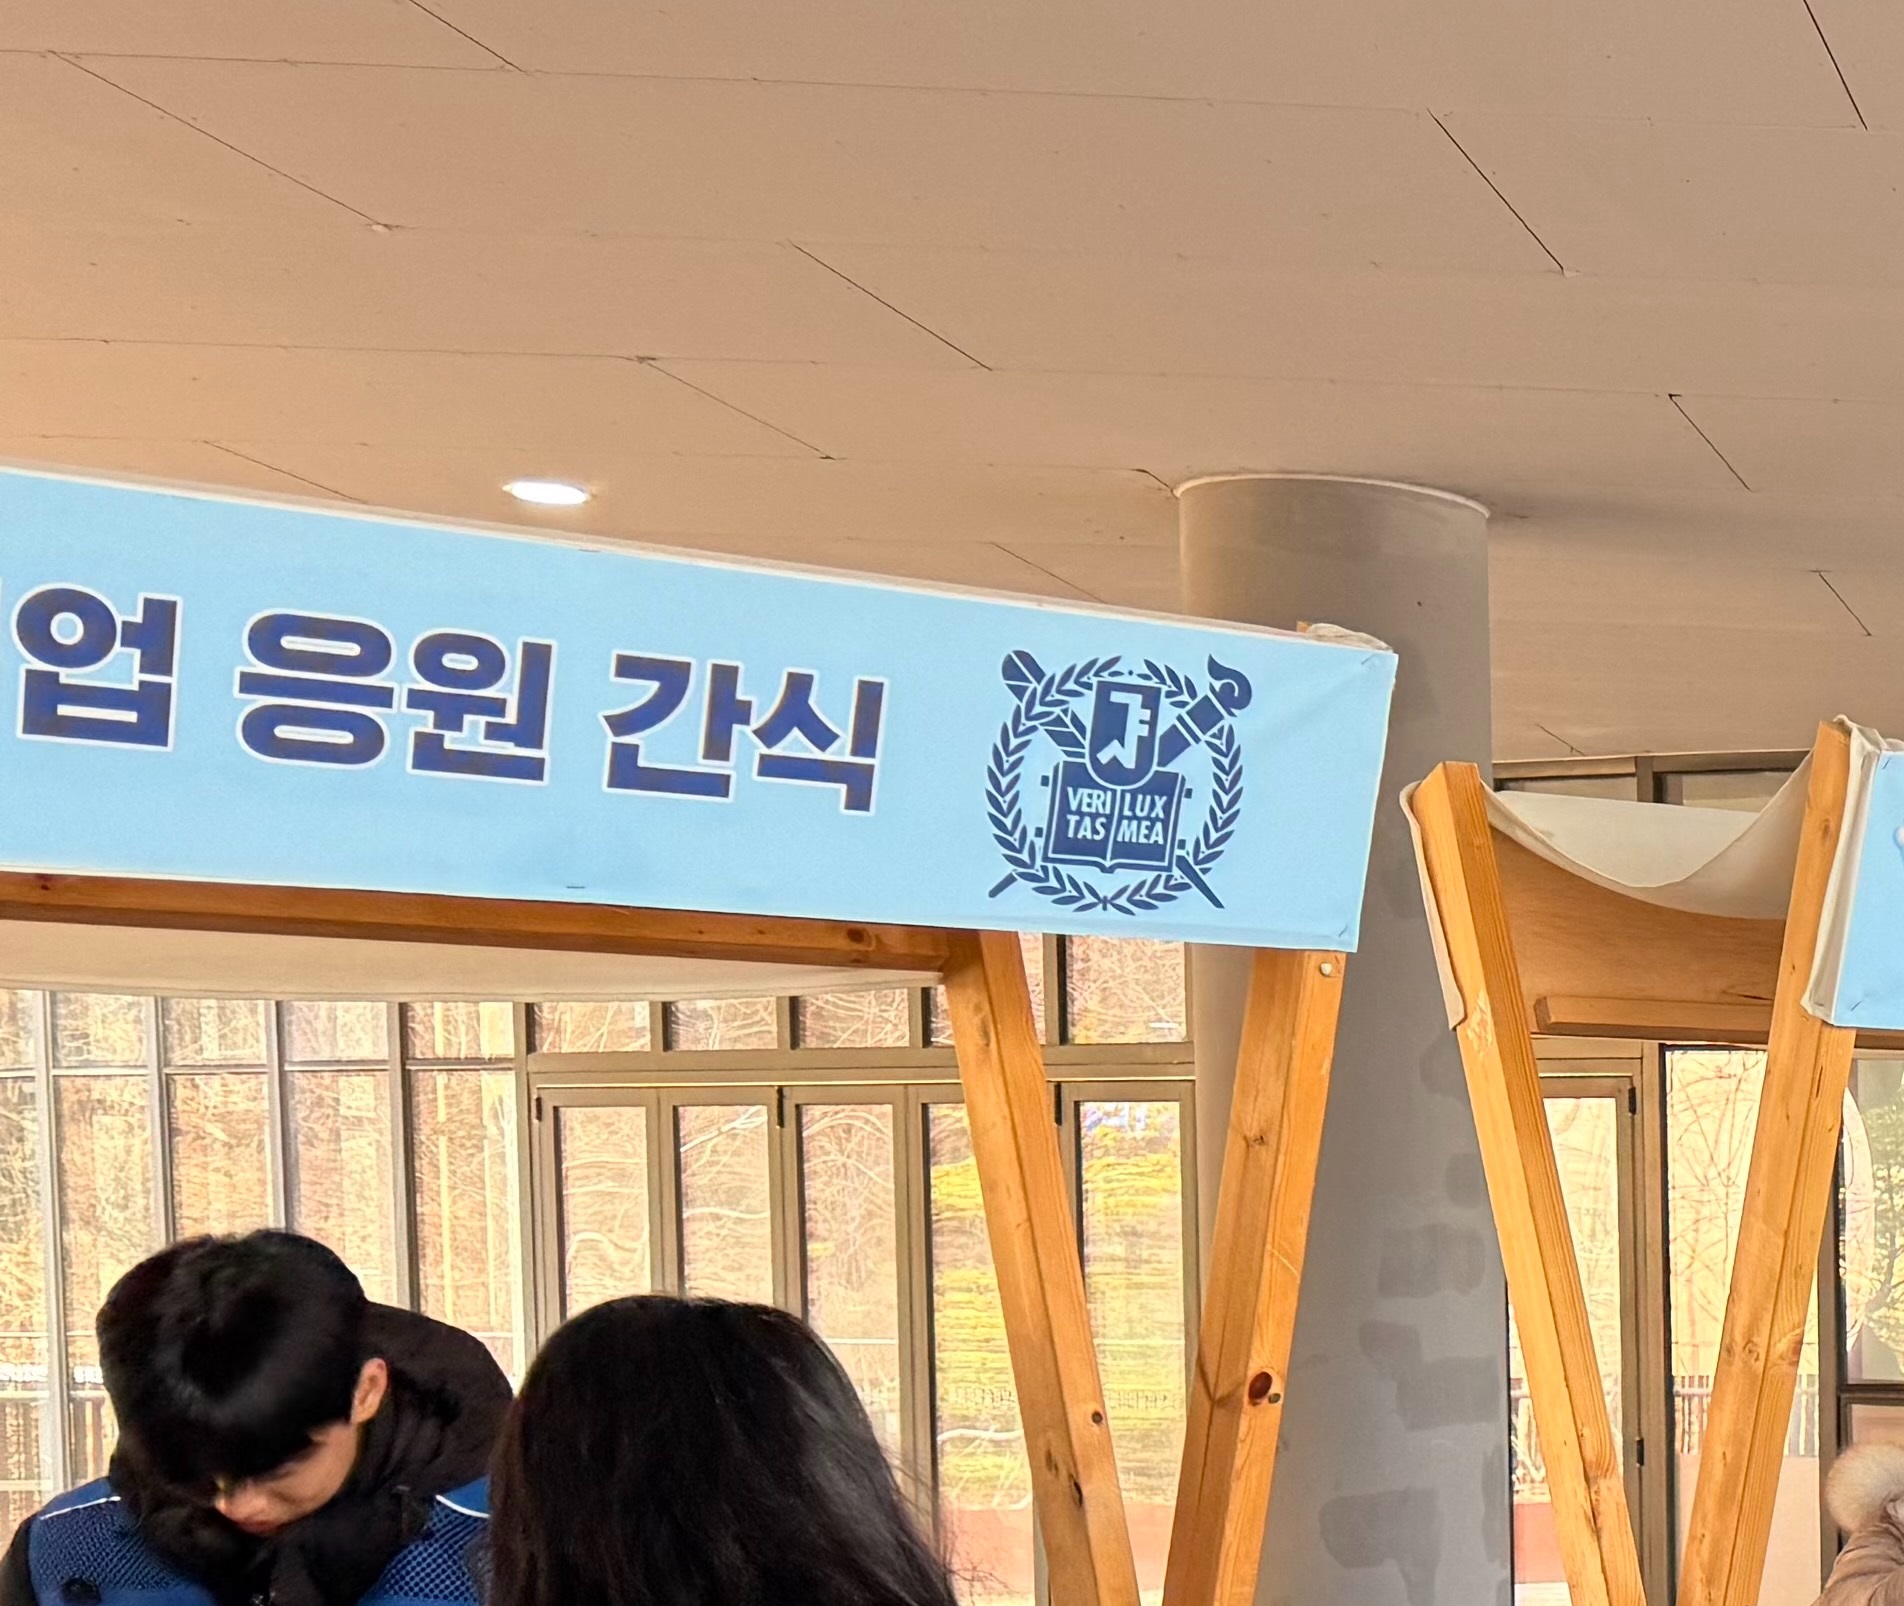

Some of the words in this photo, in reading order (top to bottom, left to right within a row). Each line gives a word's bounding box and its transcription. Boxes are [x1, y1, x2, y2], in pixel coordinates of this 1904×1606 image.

[13, 586, 180, 749] 업
[236, 611, 554, 785] 응원
[604, 654, 888, 813] 간식
[1066, 785, 1113, 815] VERI
[1122, 791, 1168, 819] LUX
[1065, 813, 1107, 841] TAS
[1116, 818, 1165, 845] MEA
